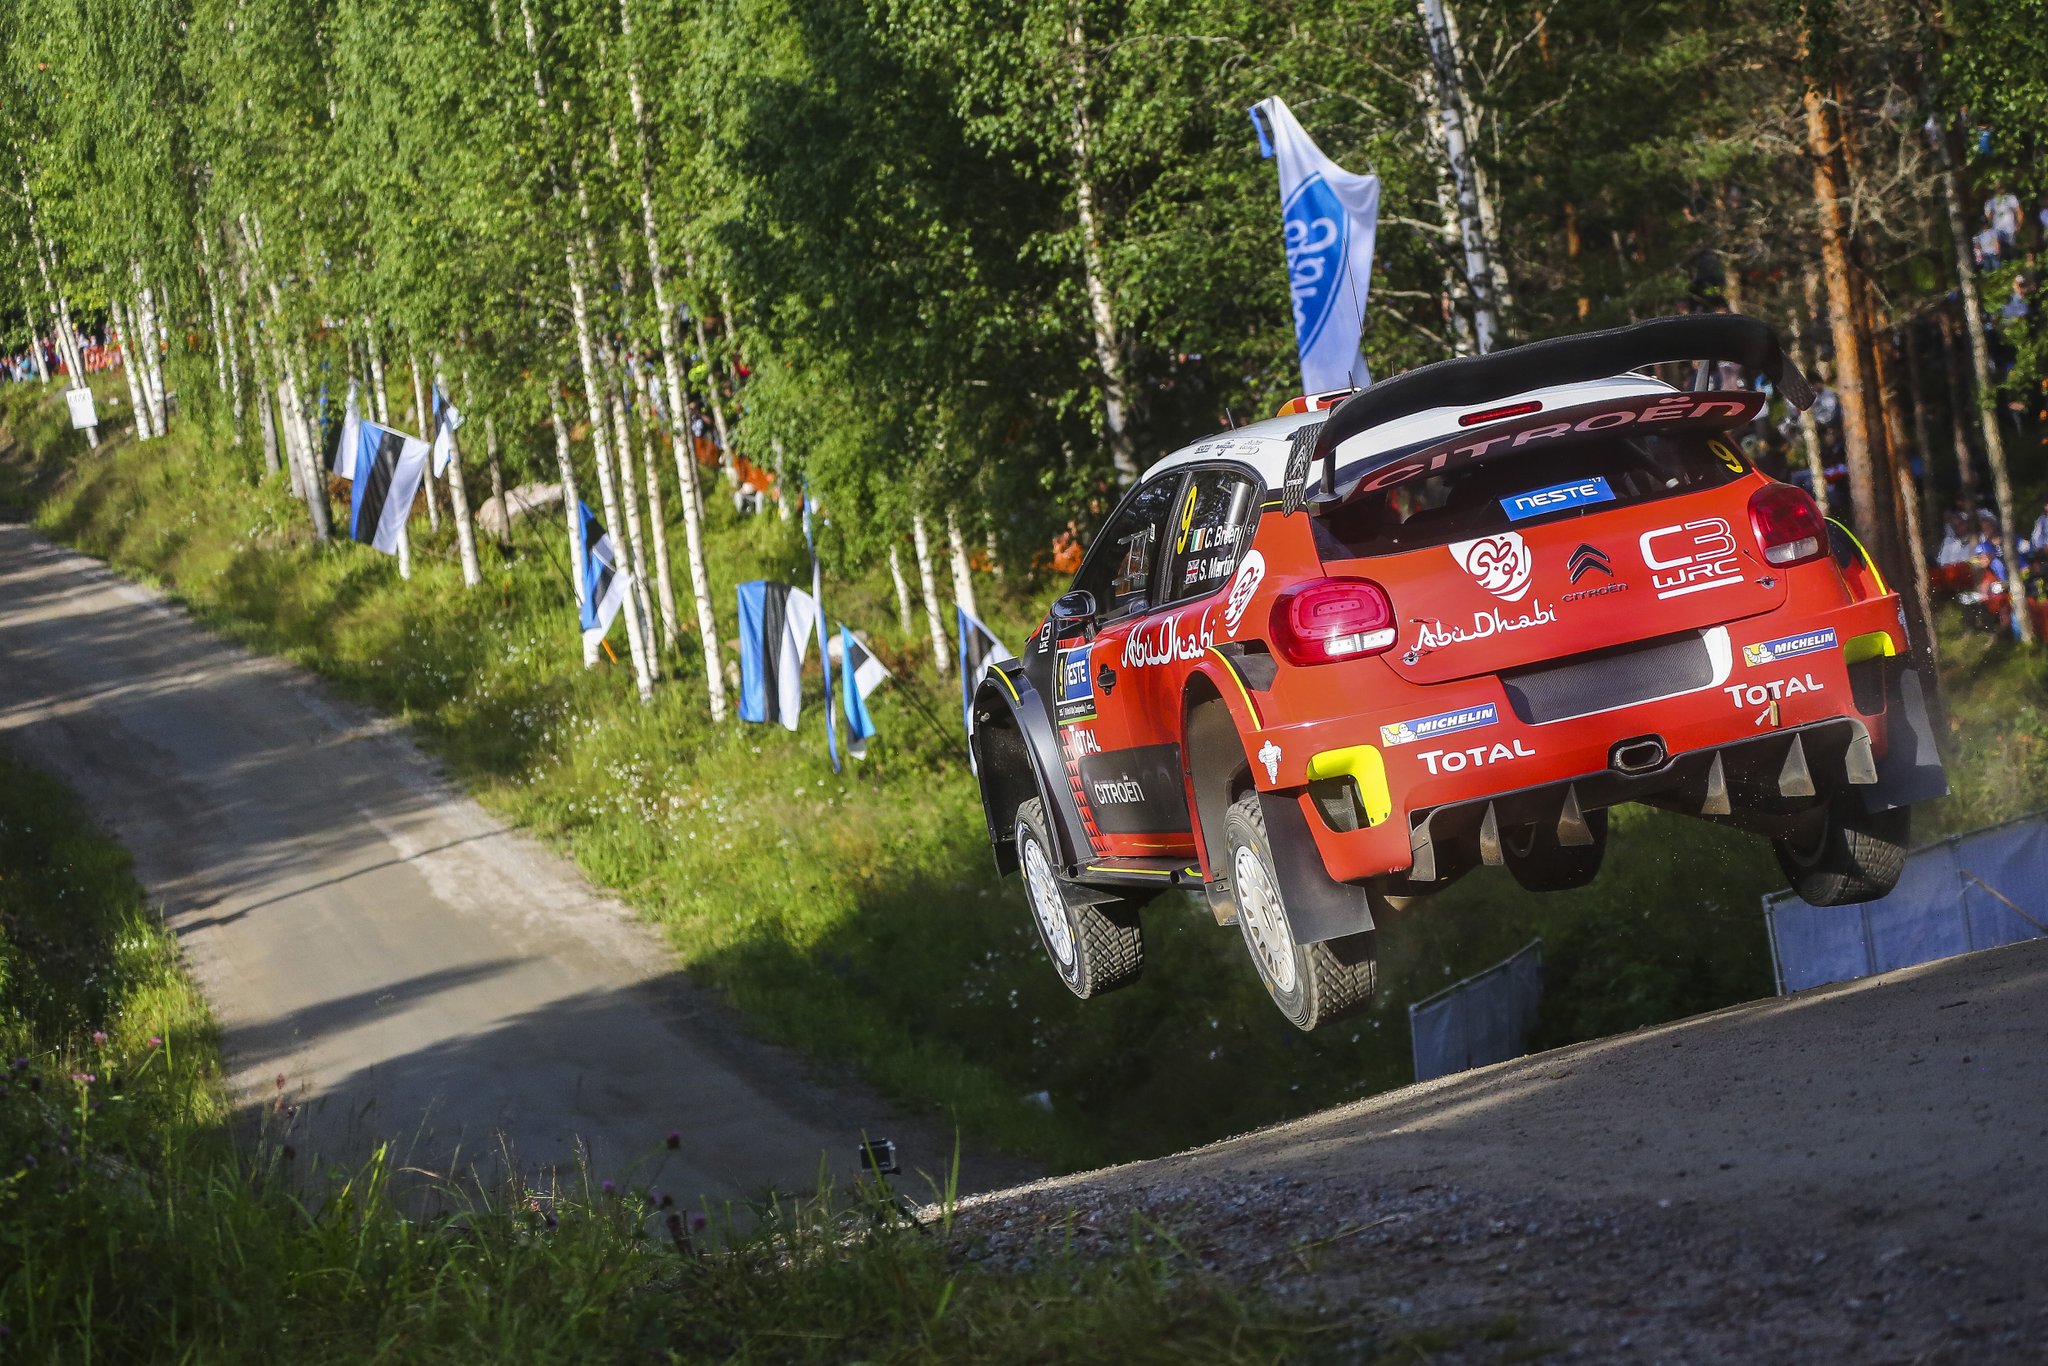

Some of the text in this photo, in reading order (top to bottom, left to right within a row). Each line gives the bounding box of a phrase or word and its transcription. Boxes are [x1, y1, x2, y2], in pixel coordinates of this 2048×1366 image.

[1362, 396, 1746, 493] CITROËN
[1707, 439, 1744, 473] 9
[1515, 484, 1599, 511] NESTE
[1177, 485, 1198, 555] 9
[1204, 529, 1213, 548] C.
[1639, 517, 1737, 571] C3
[1199, 559, 1207, 581] S.
[1652, 557, 1741, 589] WRC
[1561, 583, 1629, 602] CITROËN
[1774, 632, 1834, 654] MICHELIN
[1724, 673, 1824, 708] TOTAL
[1416, 707, 1494, 733] MICHELIN
[1067, 725, 1102, 755] TOTAL
[1416, 739, 1536, 775] TOTAL
[1094, 775, 1146, 805] CITROËN
